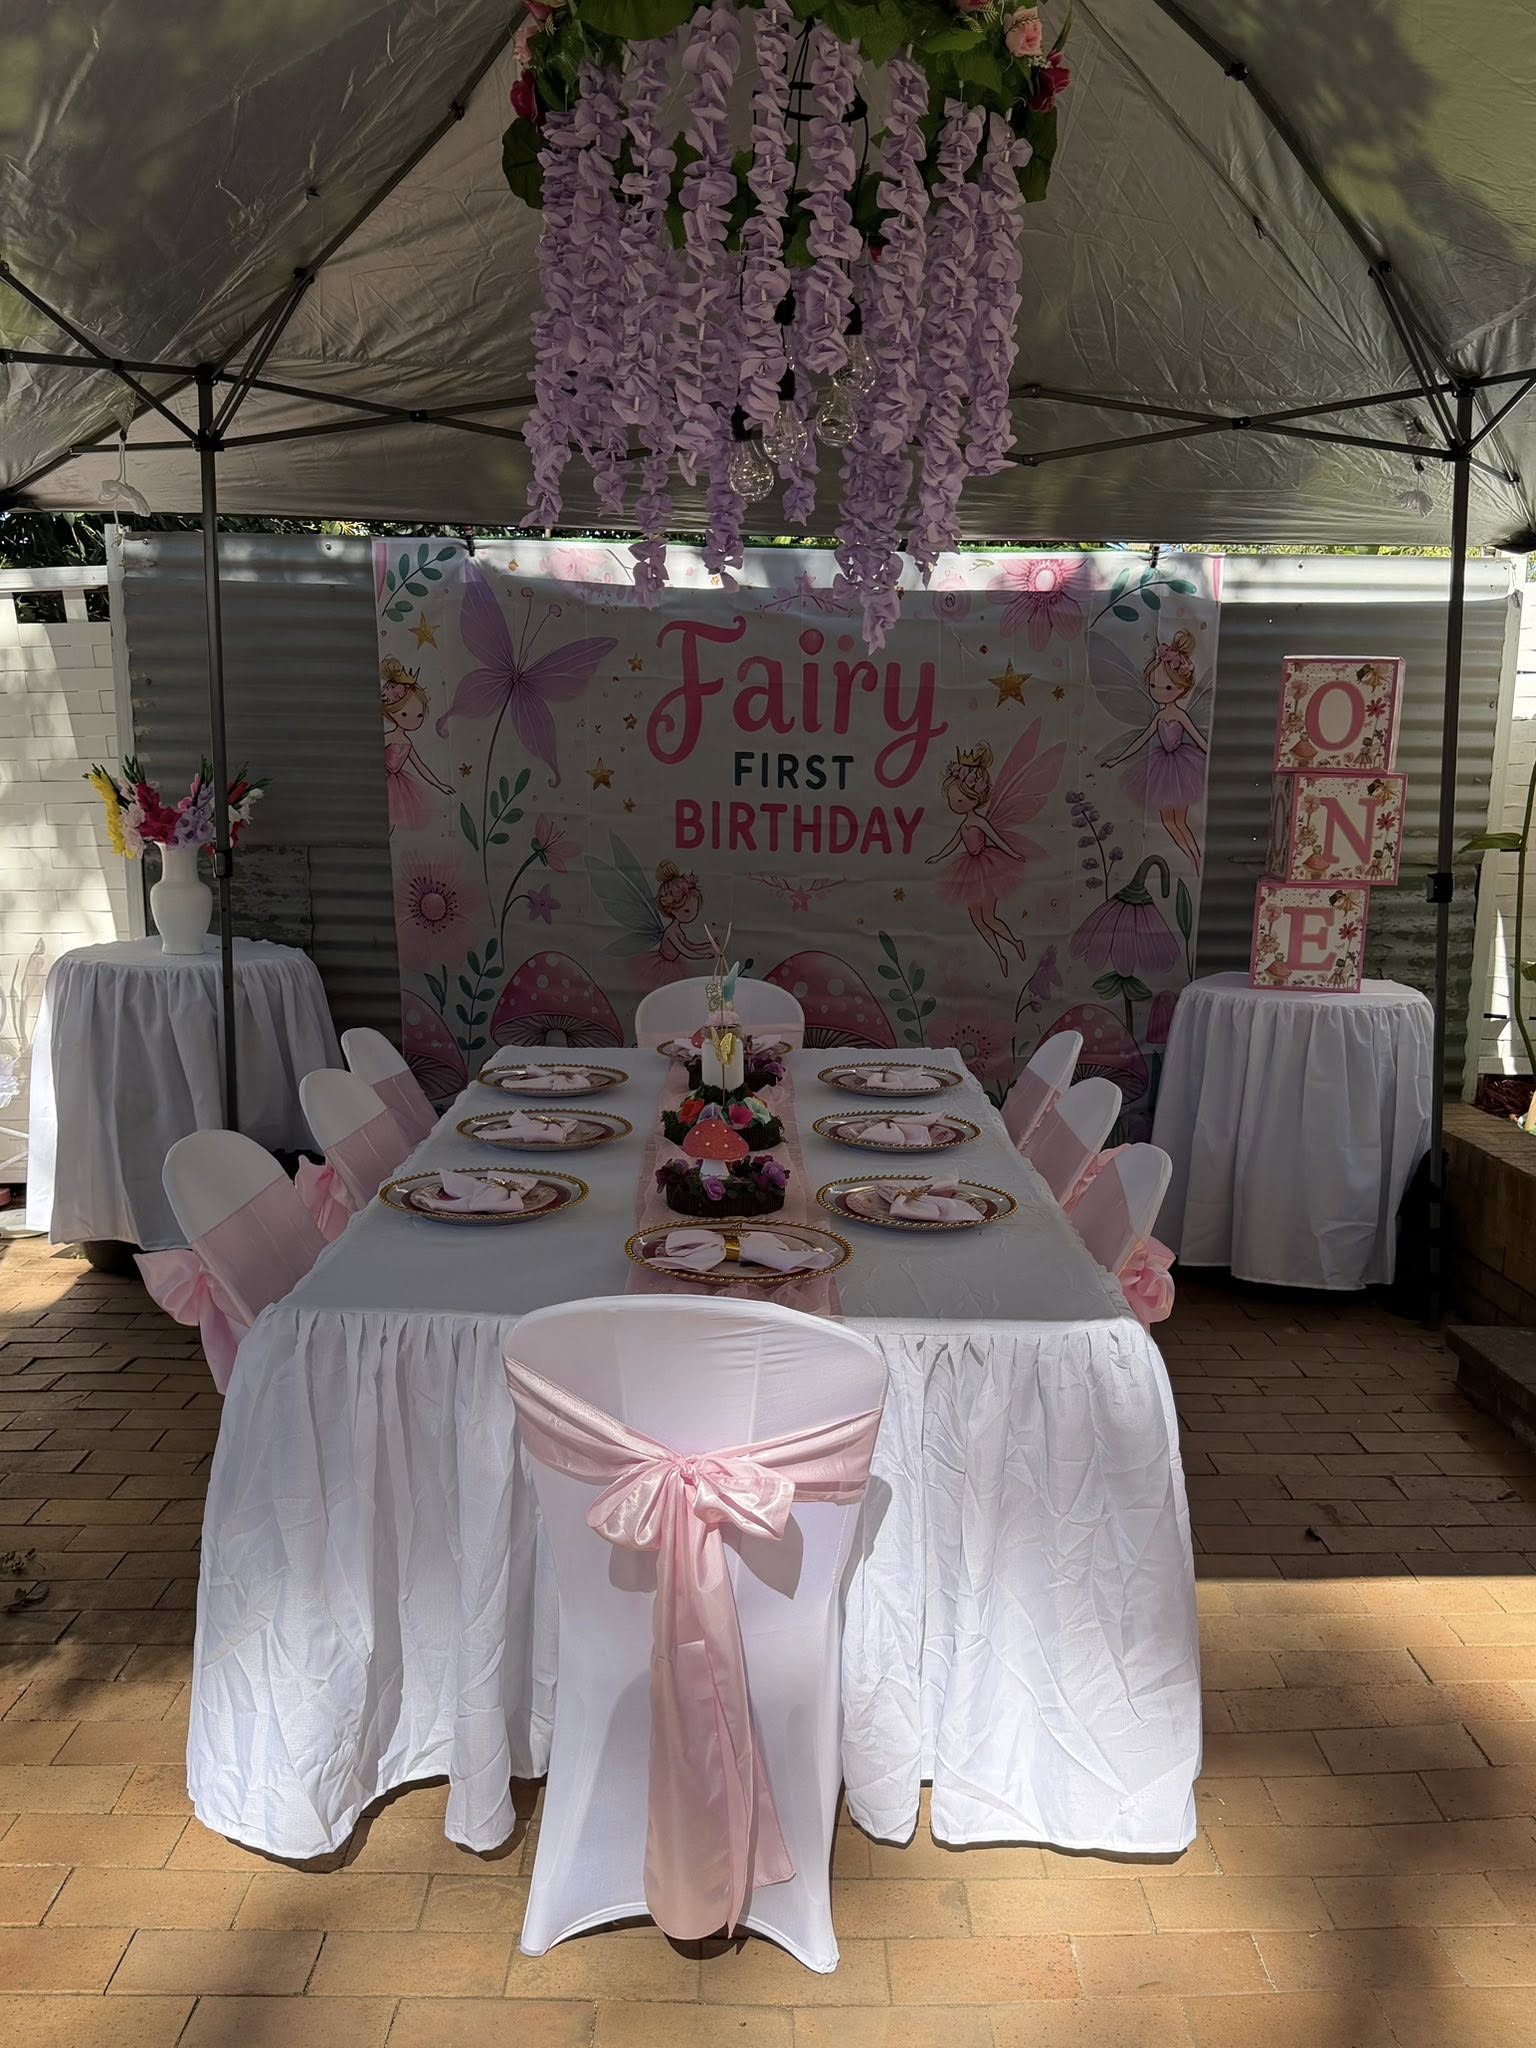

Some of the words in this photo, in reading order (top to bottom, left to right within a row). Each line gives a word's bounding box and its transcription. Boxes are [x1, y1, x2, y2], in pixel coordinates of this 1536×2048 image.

[646, 615, 949, 789] Fairy
[734, 751, 855, 790] FIRST
[675, 799, 925, 855] BIRTHDAY
